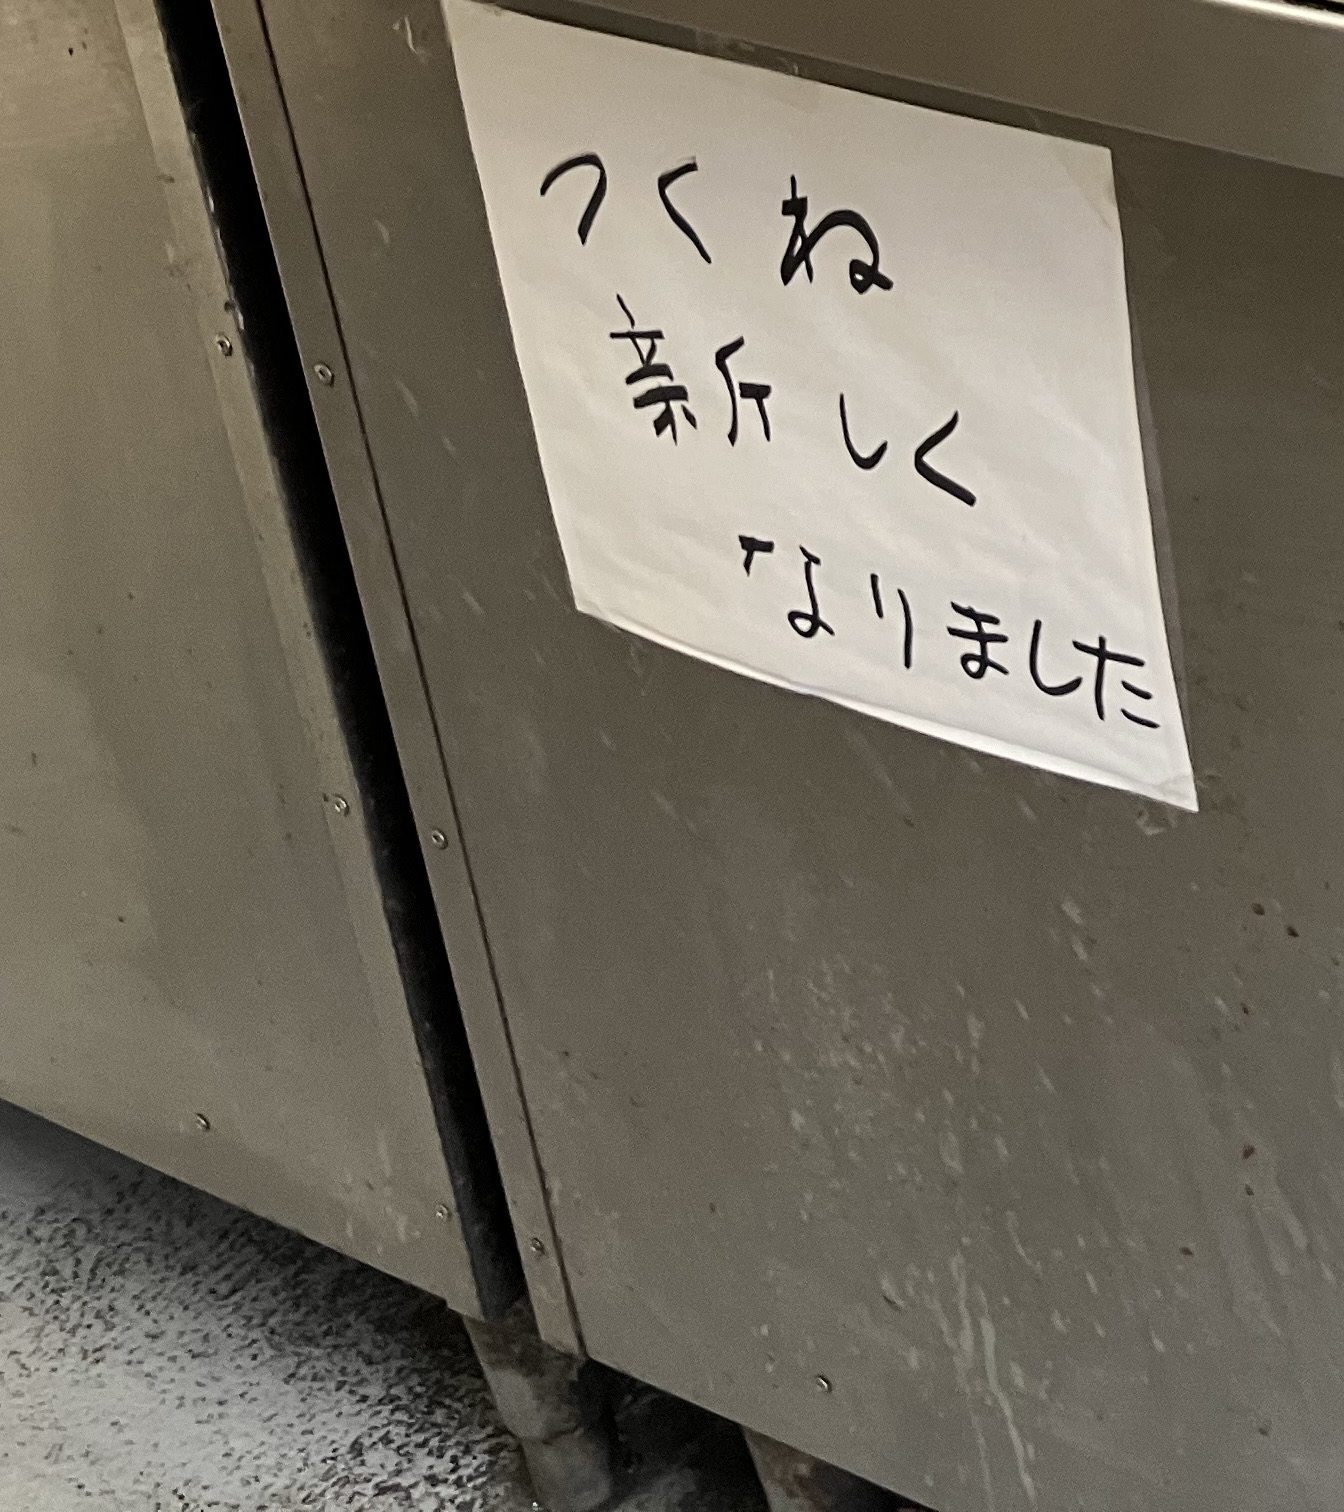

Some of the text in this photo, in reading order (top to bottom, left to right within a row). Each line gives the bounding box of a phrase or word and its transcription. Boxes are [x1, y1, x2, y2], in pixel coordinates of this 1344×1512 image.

[540, 154, 893, 294] つくね
[610, 294, 976, 506] 新しく
[737, 534, 1160, 729] なりました
